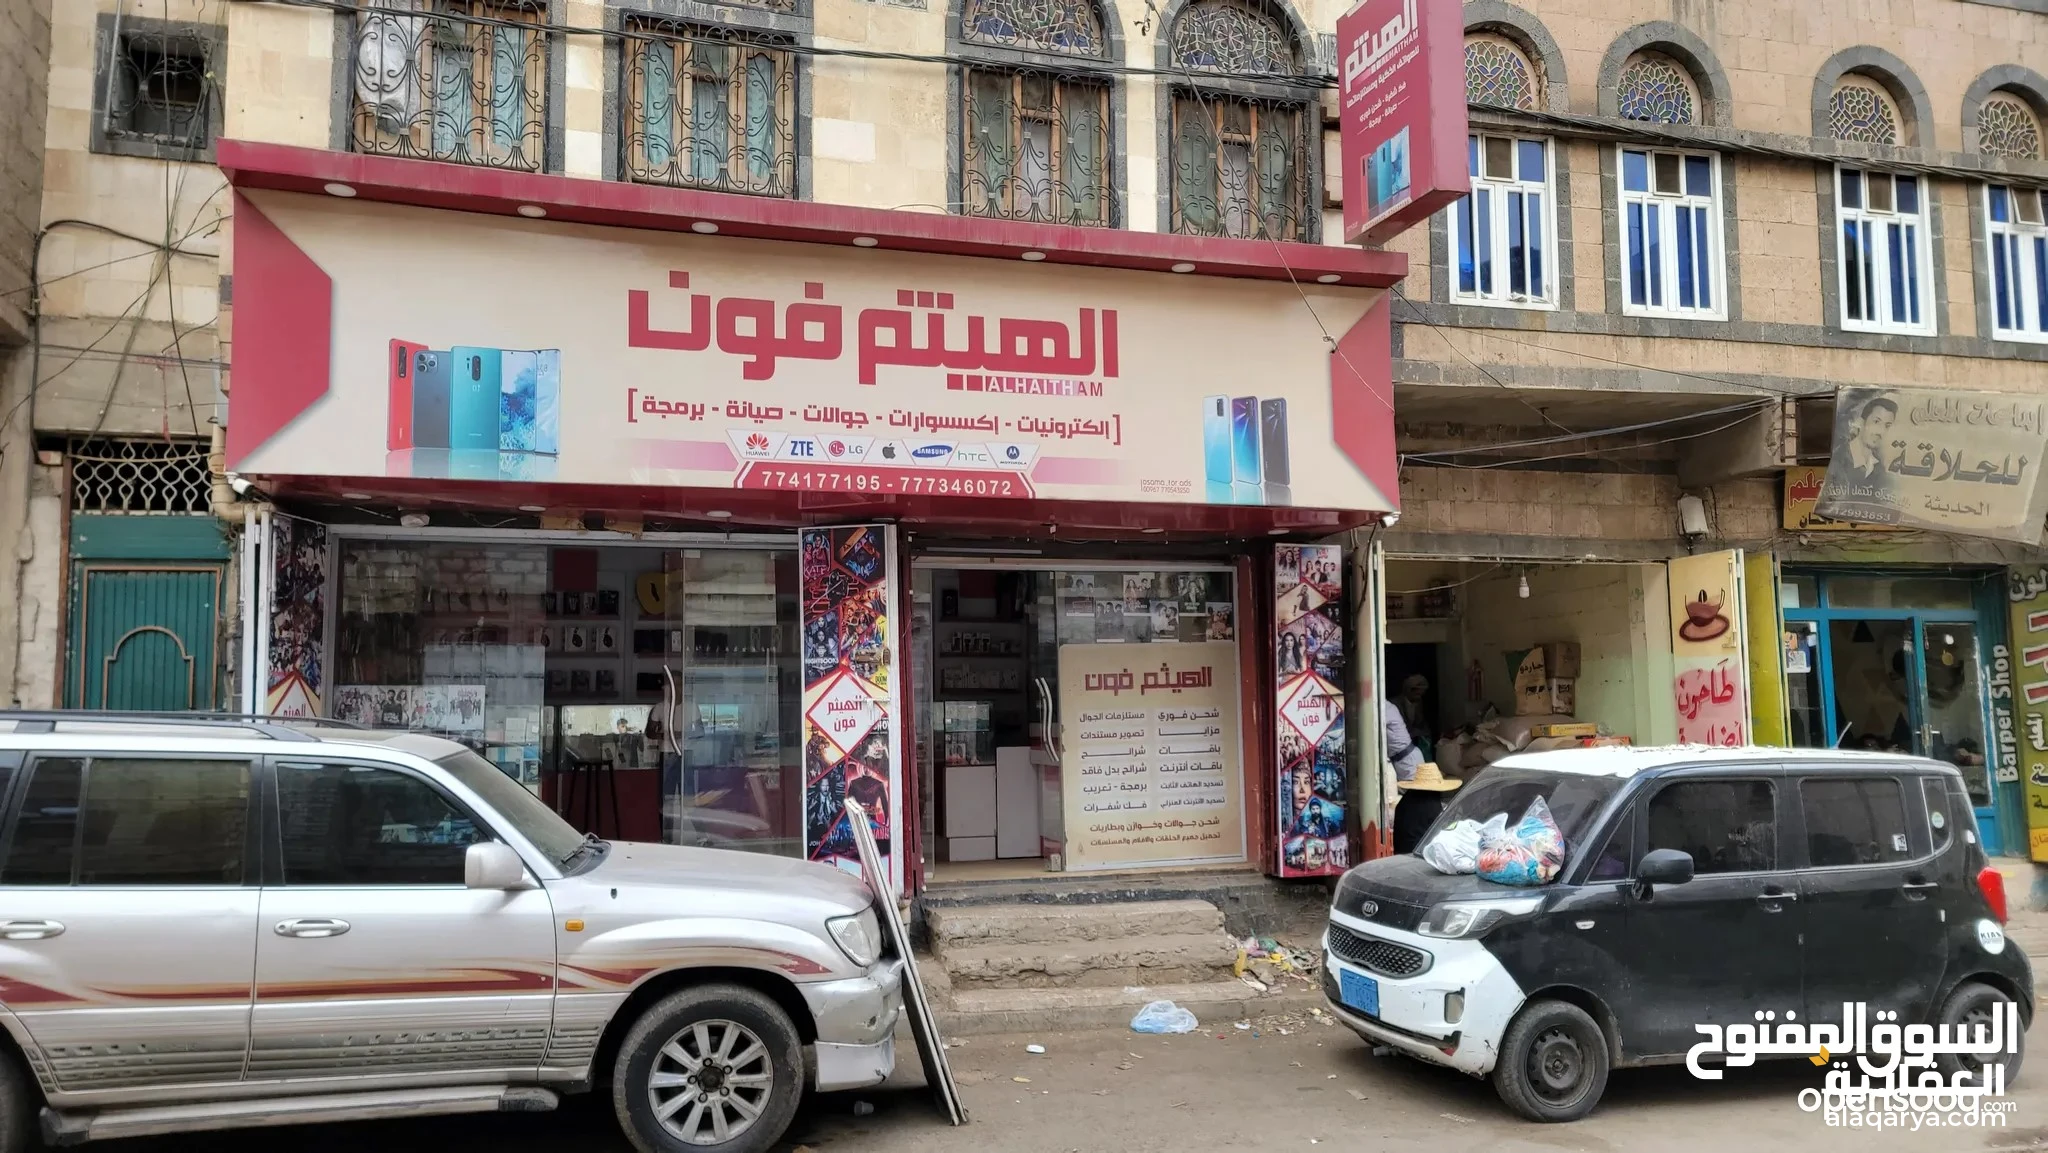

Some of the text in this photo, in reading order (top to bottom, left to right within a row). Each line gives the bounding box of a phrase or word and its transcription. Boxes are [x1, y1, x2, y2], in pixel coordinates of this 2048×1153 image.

[628, 270, 843, 381] فون
[987, 376, 1103, 397] ALHAITHAM
[726, 400, 784, 424] صيانة
[803, 404, 870, 429] جوالات
[790, 440, 814, 457] ZTE
[848, 444, 864, 455] LG
[915, 444, 951, 455] SAMSUNG
[761, 470, 881, 491] 774177195
[900, 476, 1012, 496] 777346072
[1924, 495, 1990, 518] الحديثة
[1991, 644, 2012, 699] Shop
[1085, 662, 1213, 697] الهيثم فون
[1079, 711, 1145, 723] مستلزمات الجوال
[1158, 707, 1220, 722] شحن فوري
[833, 716, 857, 732] فون
[1080, 729, 1145, 740] تصوير مستندات
[1158, 725, 1220, 737] مزايا
[1158, 744, 1221, 755] باقات
[1081, 765, 1103, 776] فاقد
[1104, 765, 1120, 776] بدل
[1190, 761, 1223, 773] باقات
[1083, 782, 1112, 795] تعريب
[1120, 782, 1148, 793] برمجة
[1083, 800, 1148, 813] فك شفرات
[1198, 815, 1220, 828] شحن
